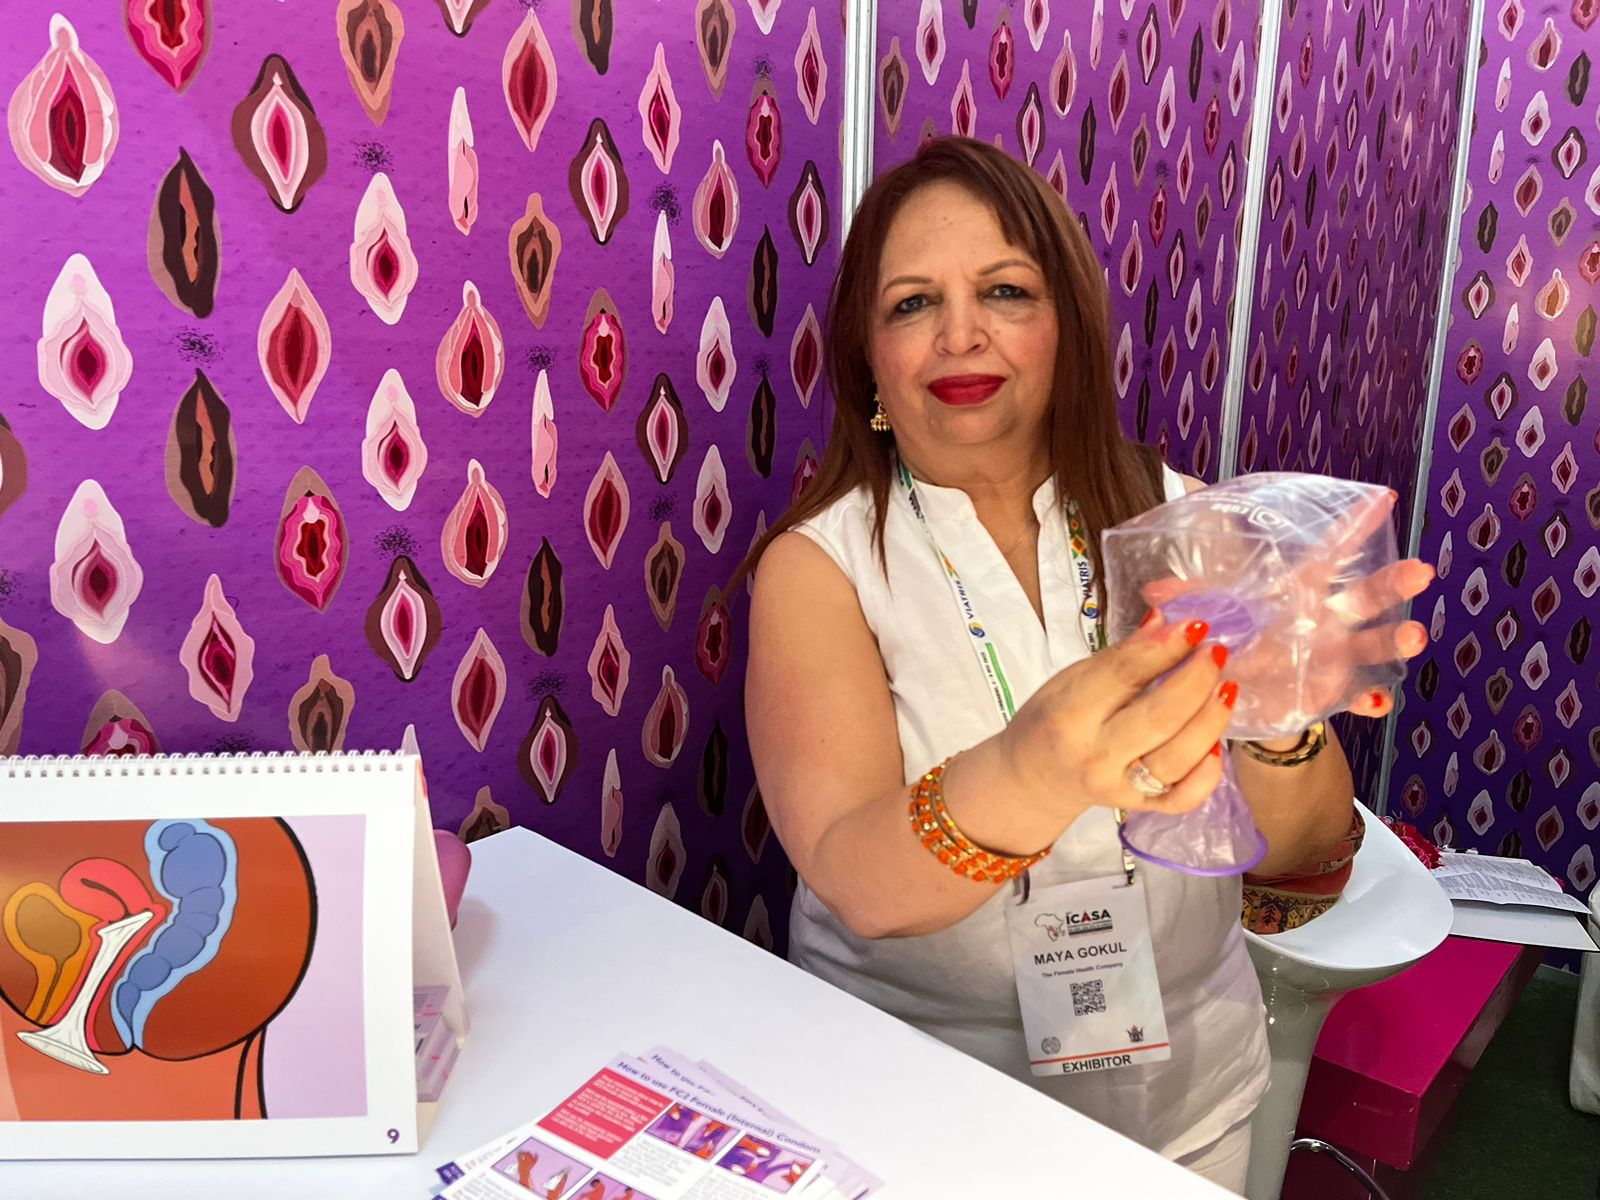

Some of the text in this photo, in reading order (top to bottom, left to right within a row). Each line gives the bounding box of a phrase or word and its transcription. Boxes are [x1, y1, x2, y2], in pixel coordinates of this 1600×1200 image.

[1077, 561, 1092, 599] VIATRIS
[955, 580, 974, 619] VIATRIS
[1065, 909, 1112, 925] ICASA
[1033, 942, 1128, 965] MAYA GOKUL
[1053, 969, 1075, 977] Female
[1075, 965, 1095, 973] Health
[1095, 962, 1124, 970] Company
[1062, 1054, 1132, 1073] EXHIBITOR
[617, 1061, 639, 1076] How
[640, 1072, 652, 1082] to
[651, 1079, 669, 1090] use
[669, 1086, 690, 1100] FC2
[689, 1097, 726, 1117] Female
[726, 1112, 775, 1138] (Internal)
[776, 1133, 821, 1154] Condom
[386, 1127, 401, 1145] 9
